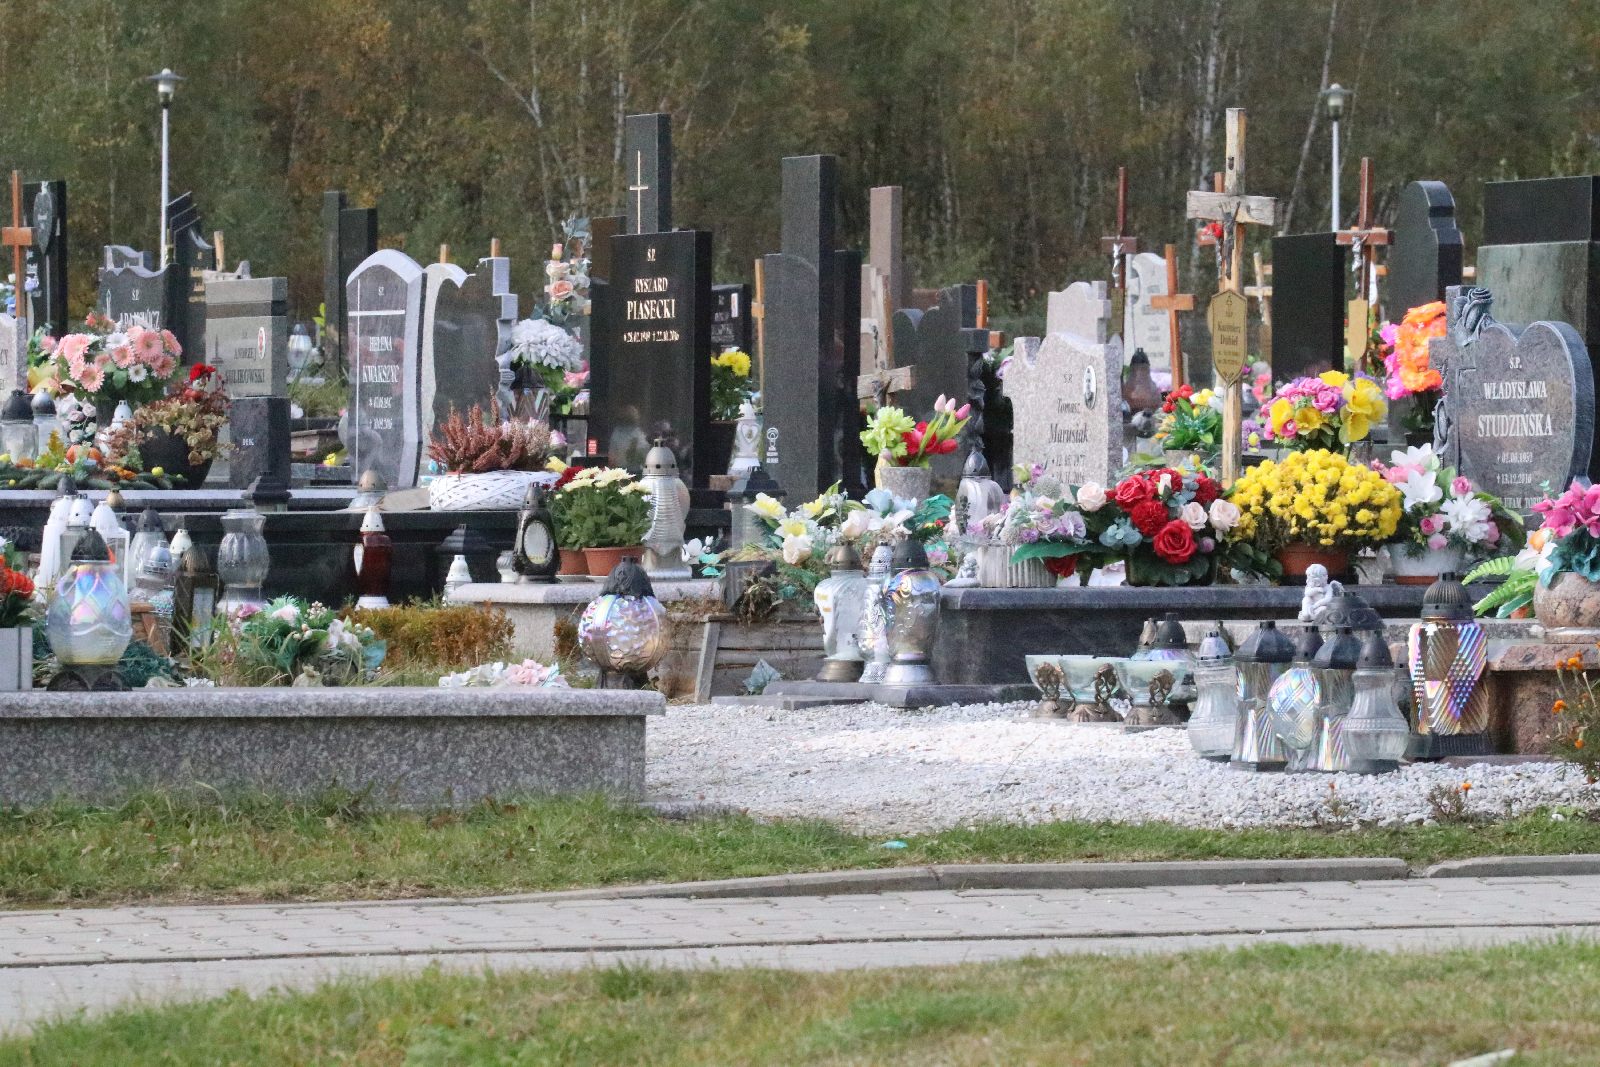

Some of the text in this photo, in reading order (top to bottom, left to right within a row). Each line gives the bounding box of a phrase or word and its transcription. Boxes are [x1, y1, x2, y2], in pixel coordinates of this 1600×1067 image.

[635, 277, 668, 293] RYSZARD
[627, 298, 676, 320] PIASECKI
[369, 336, 393, 352] HELENA
[1483, 380, 1548, 400] WŁADYSŁAWA
[1057, 398, 1081, 414] Tomasz
[1477, 408, 1553, 438] STUDZIŃSKA
[1048, 423, 1088, 444] Marusiak
